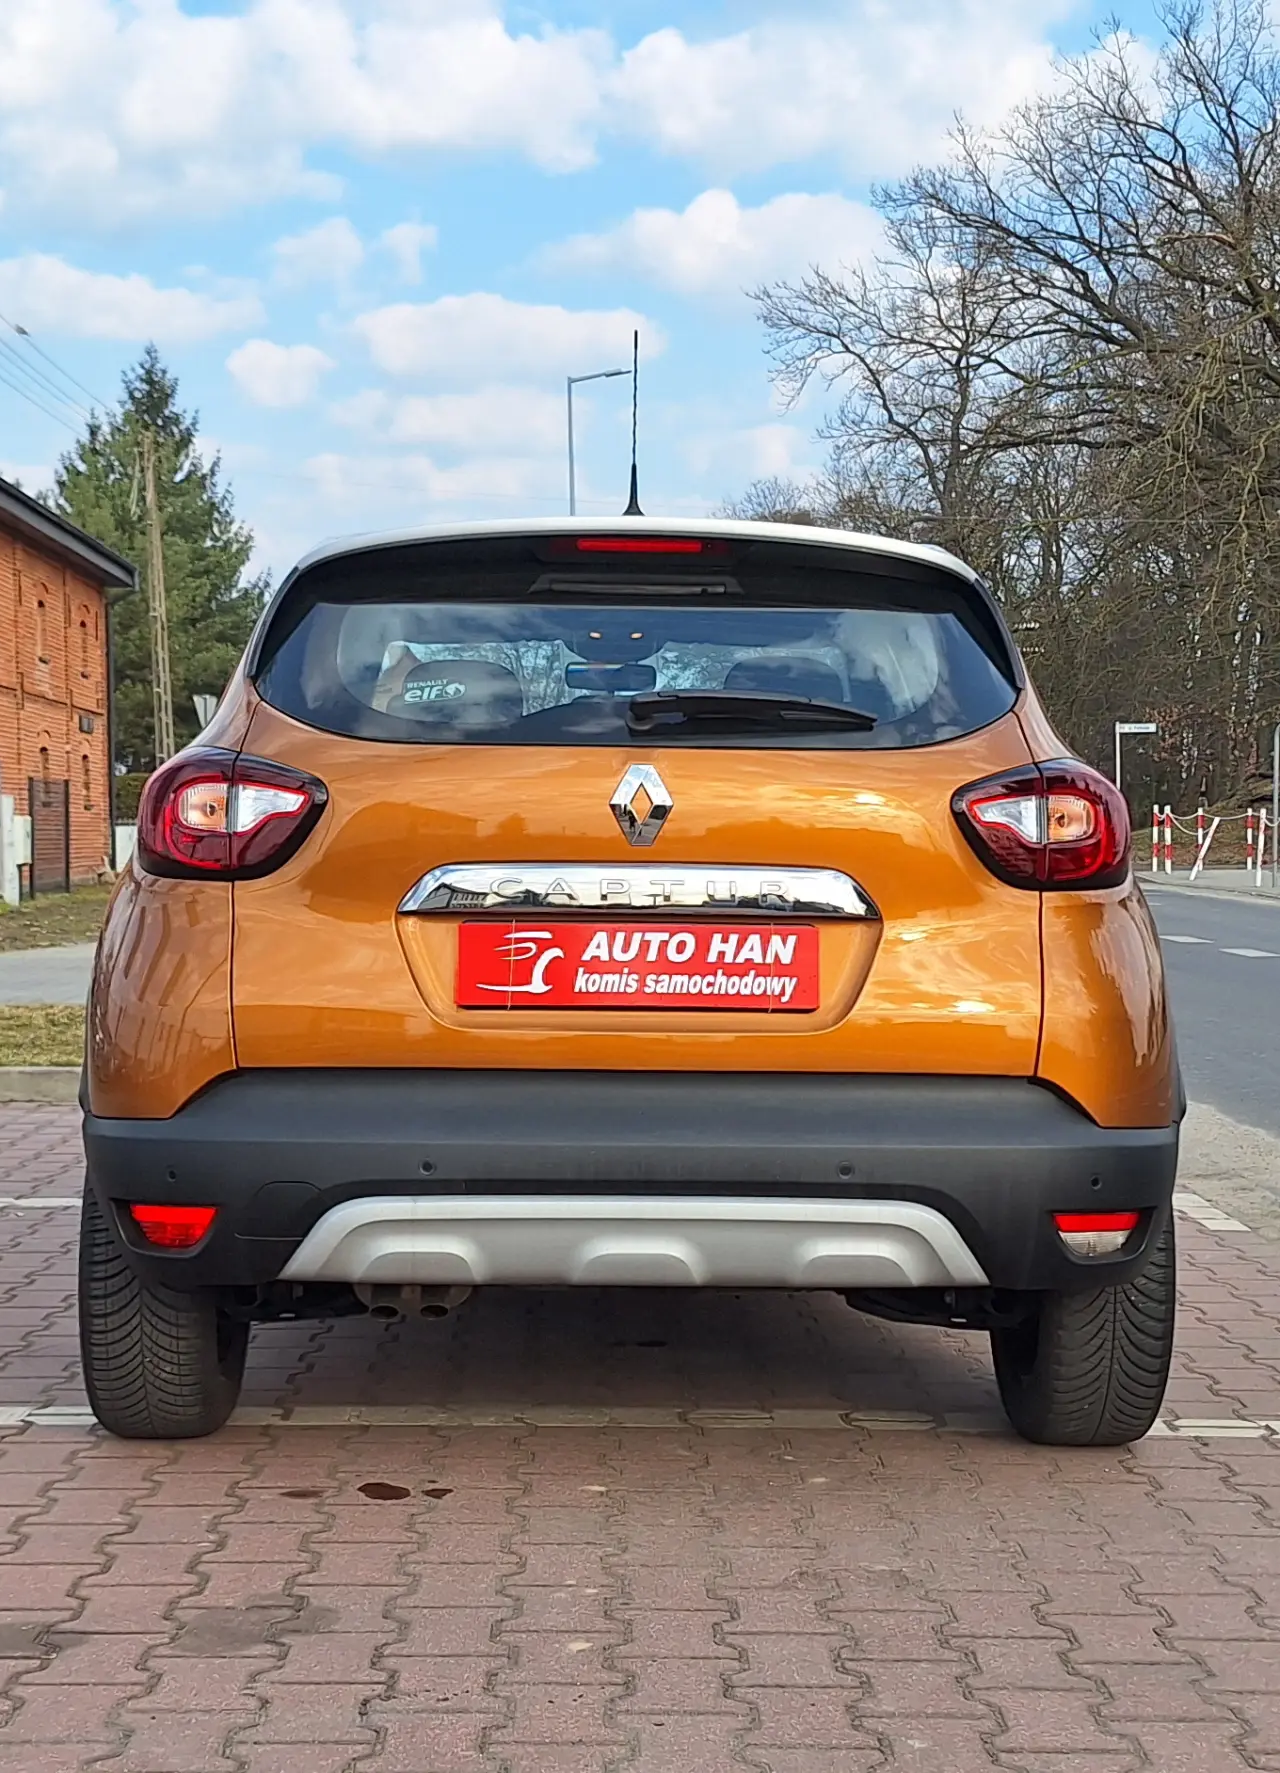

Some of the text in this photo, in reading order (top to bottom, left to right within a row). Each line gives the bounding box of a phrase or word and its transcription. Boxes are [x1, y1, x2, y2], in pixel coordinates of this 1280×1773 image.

[404, 685, 443, 701] elf
[407, 679, 447, 688] RENAULT
[489, 876, 795, 904] CAPTUR
[581, 931, 797, 965] AUTO HAN
[574, 967, 797, 1003] komis samochodowy
